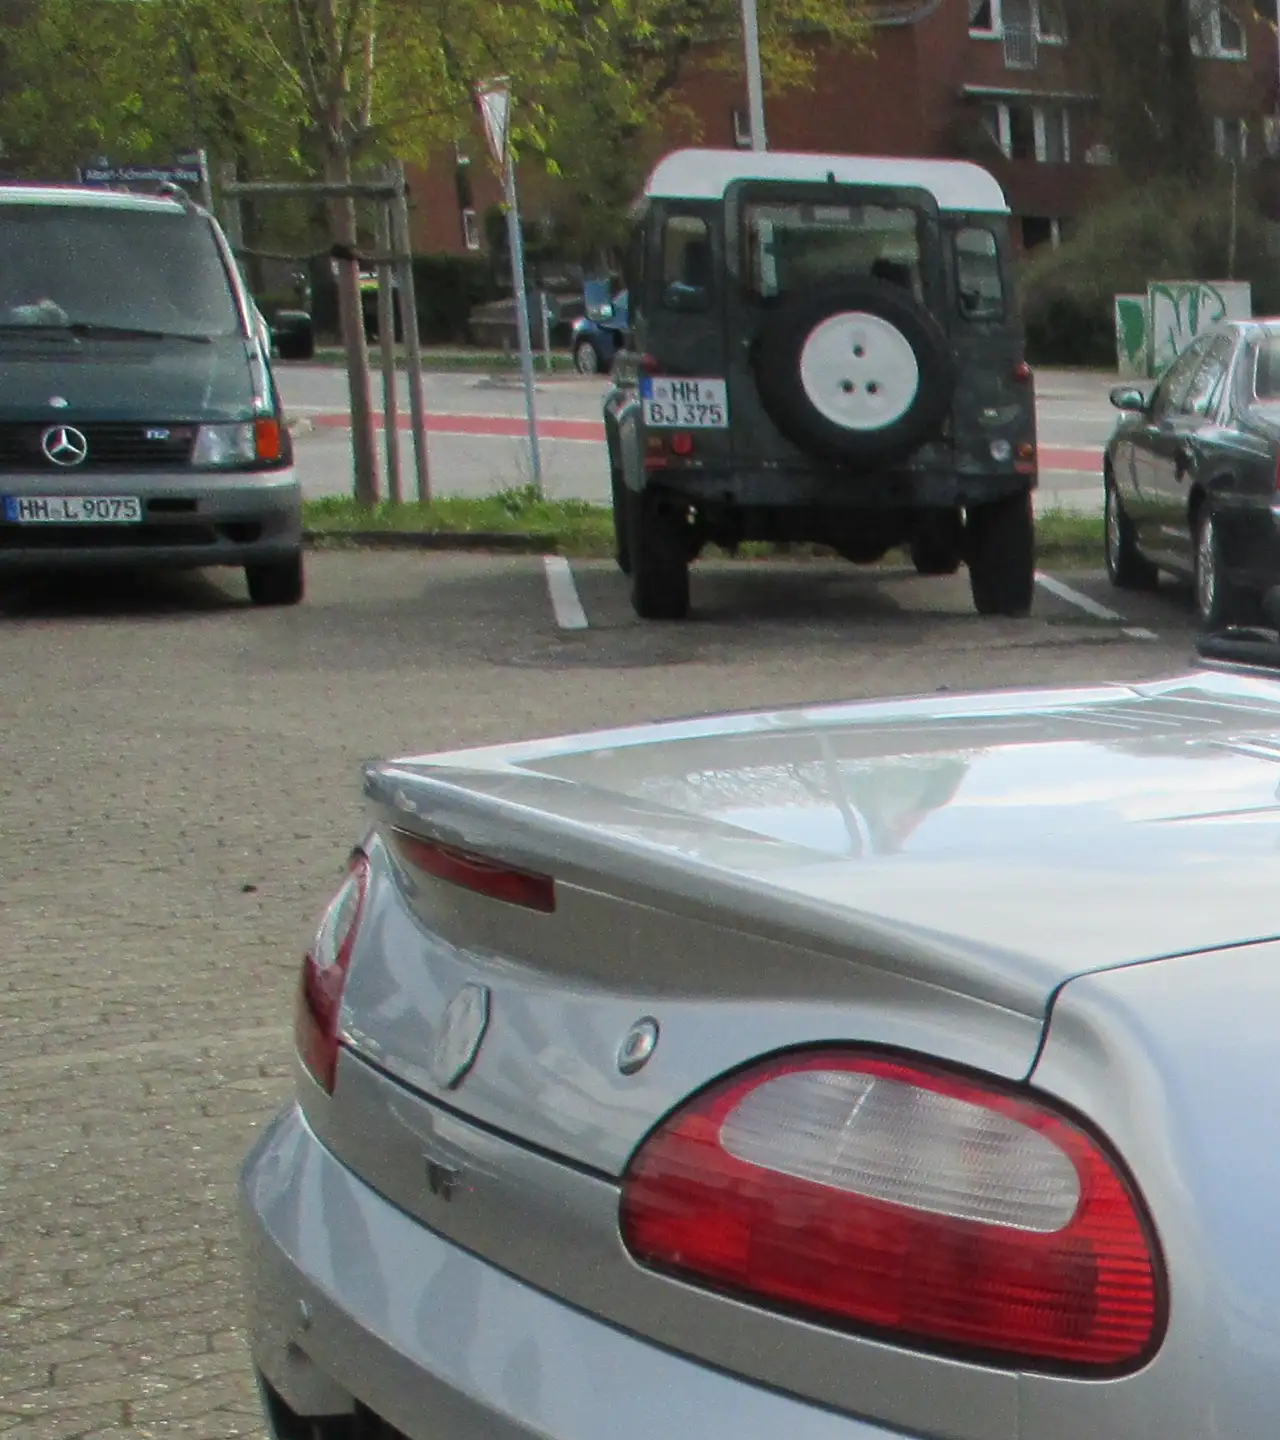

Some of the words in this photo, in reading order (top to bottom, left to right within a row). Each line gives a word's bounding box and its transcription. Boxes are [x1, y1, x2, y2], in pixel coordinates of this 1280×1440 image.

[672, 382, 700, 401] HH
[650, 403, 679, 423] BJ
[683, 404, 722, 425] 375
[19, 500, 49, 519] HH
[63, 501, 78, 519] L
[83, 501, 137, 519] 9075
